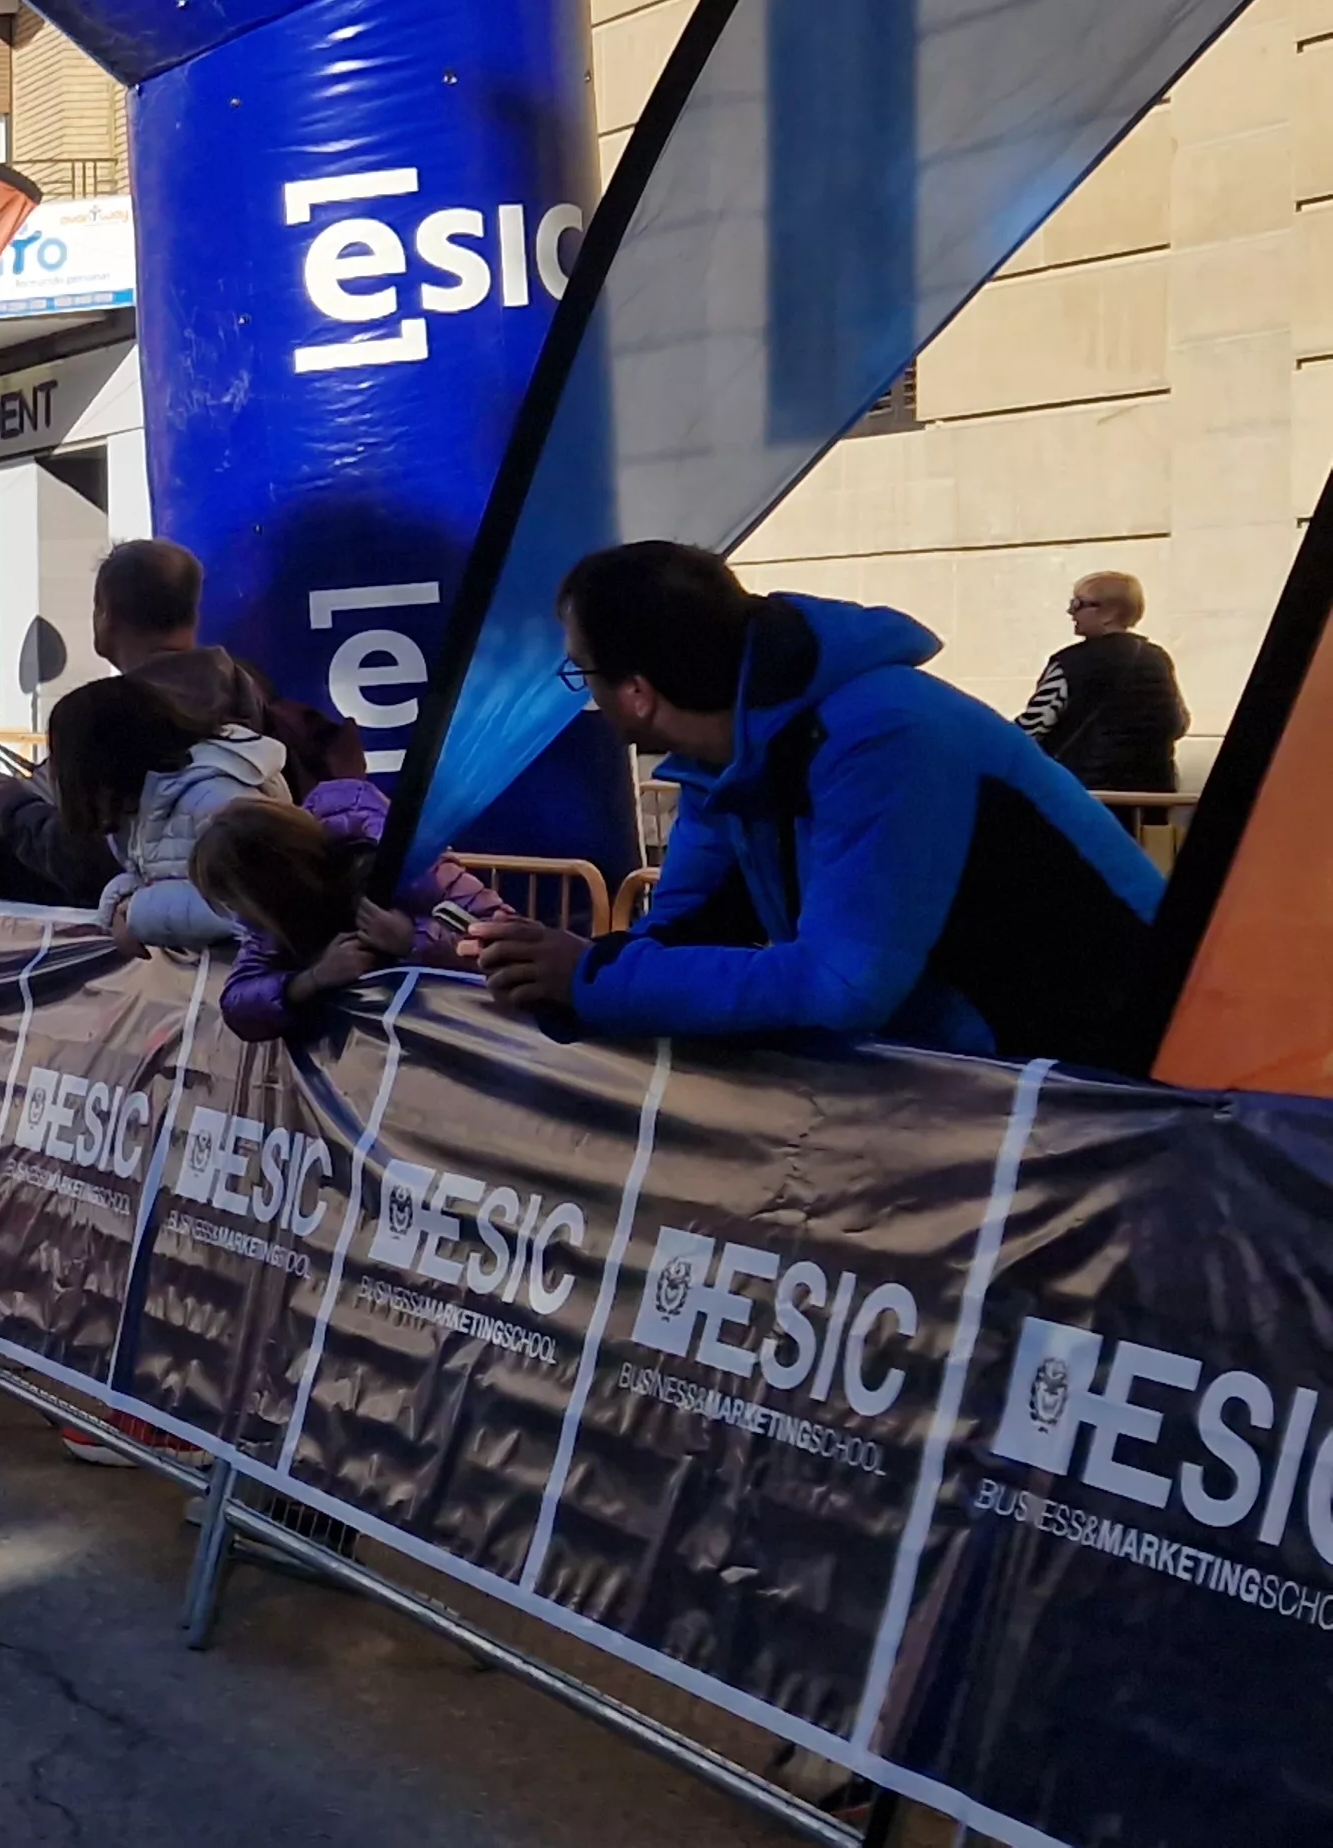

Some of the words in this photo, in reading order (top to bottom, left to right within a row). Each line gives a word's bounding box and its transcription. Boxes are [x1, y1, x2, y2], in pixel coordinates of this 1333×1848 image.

[45, 1073, 150, 1179] ESIC
[212, 1114, 333, 1237] ESIC
[416, 1171, 585, 1316] ESIC
[696, 1241, 918, 1417] ESIC
[1080, 1339, 1333, 1567] ESI
